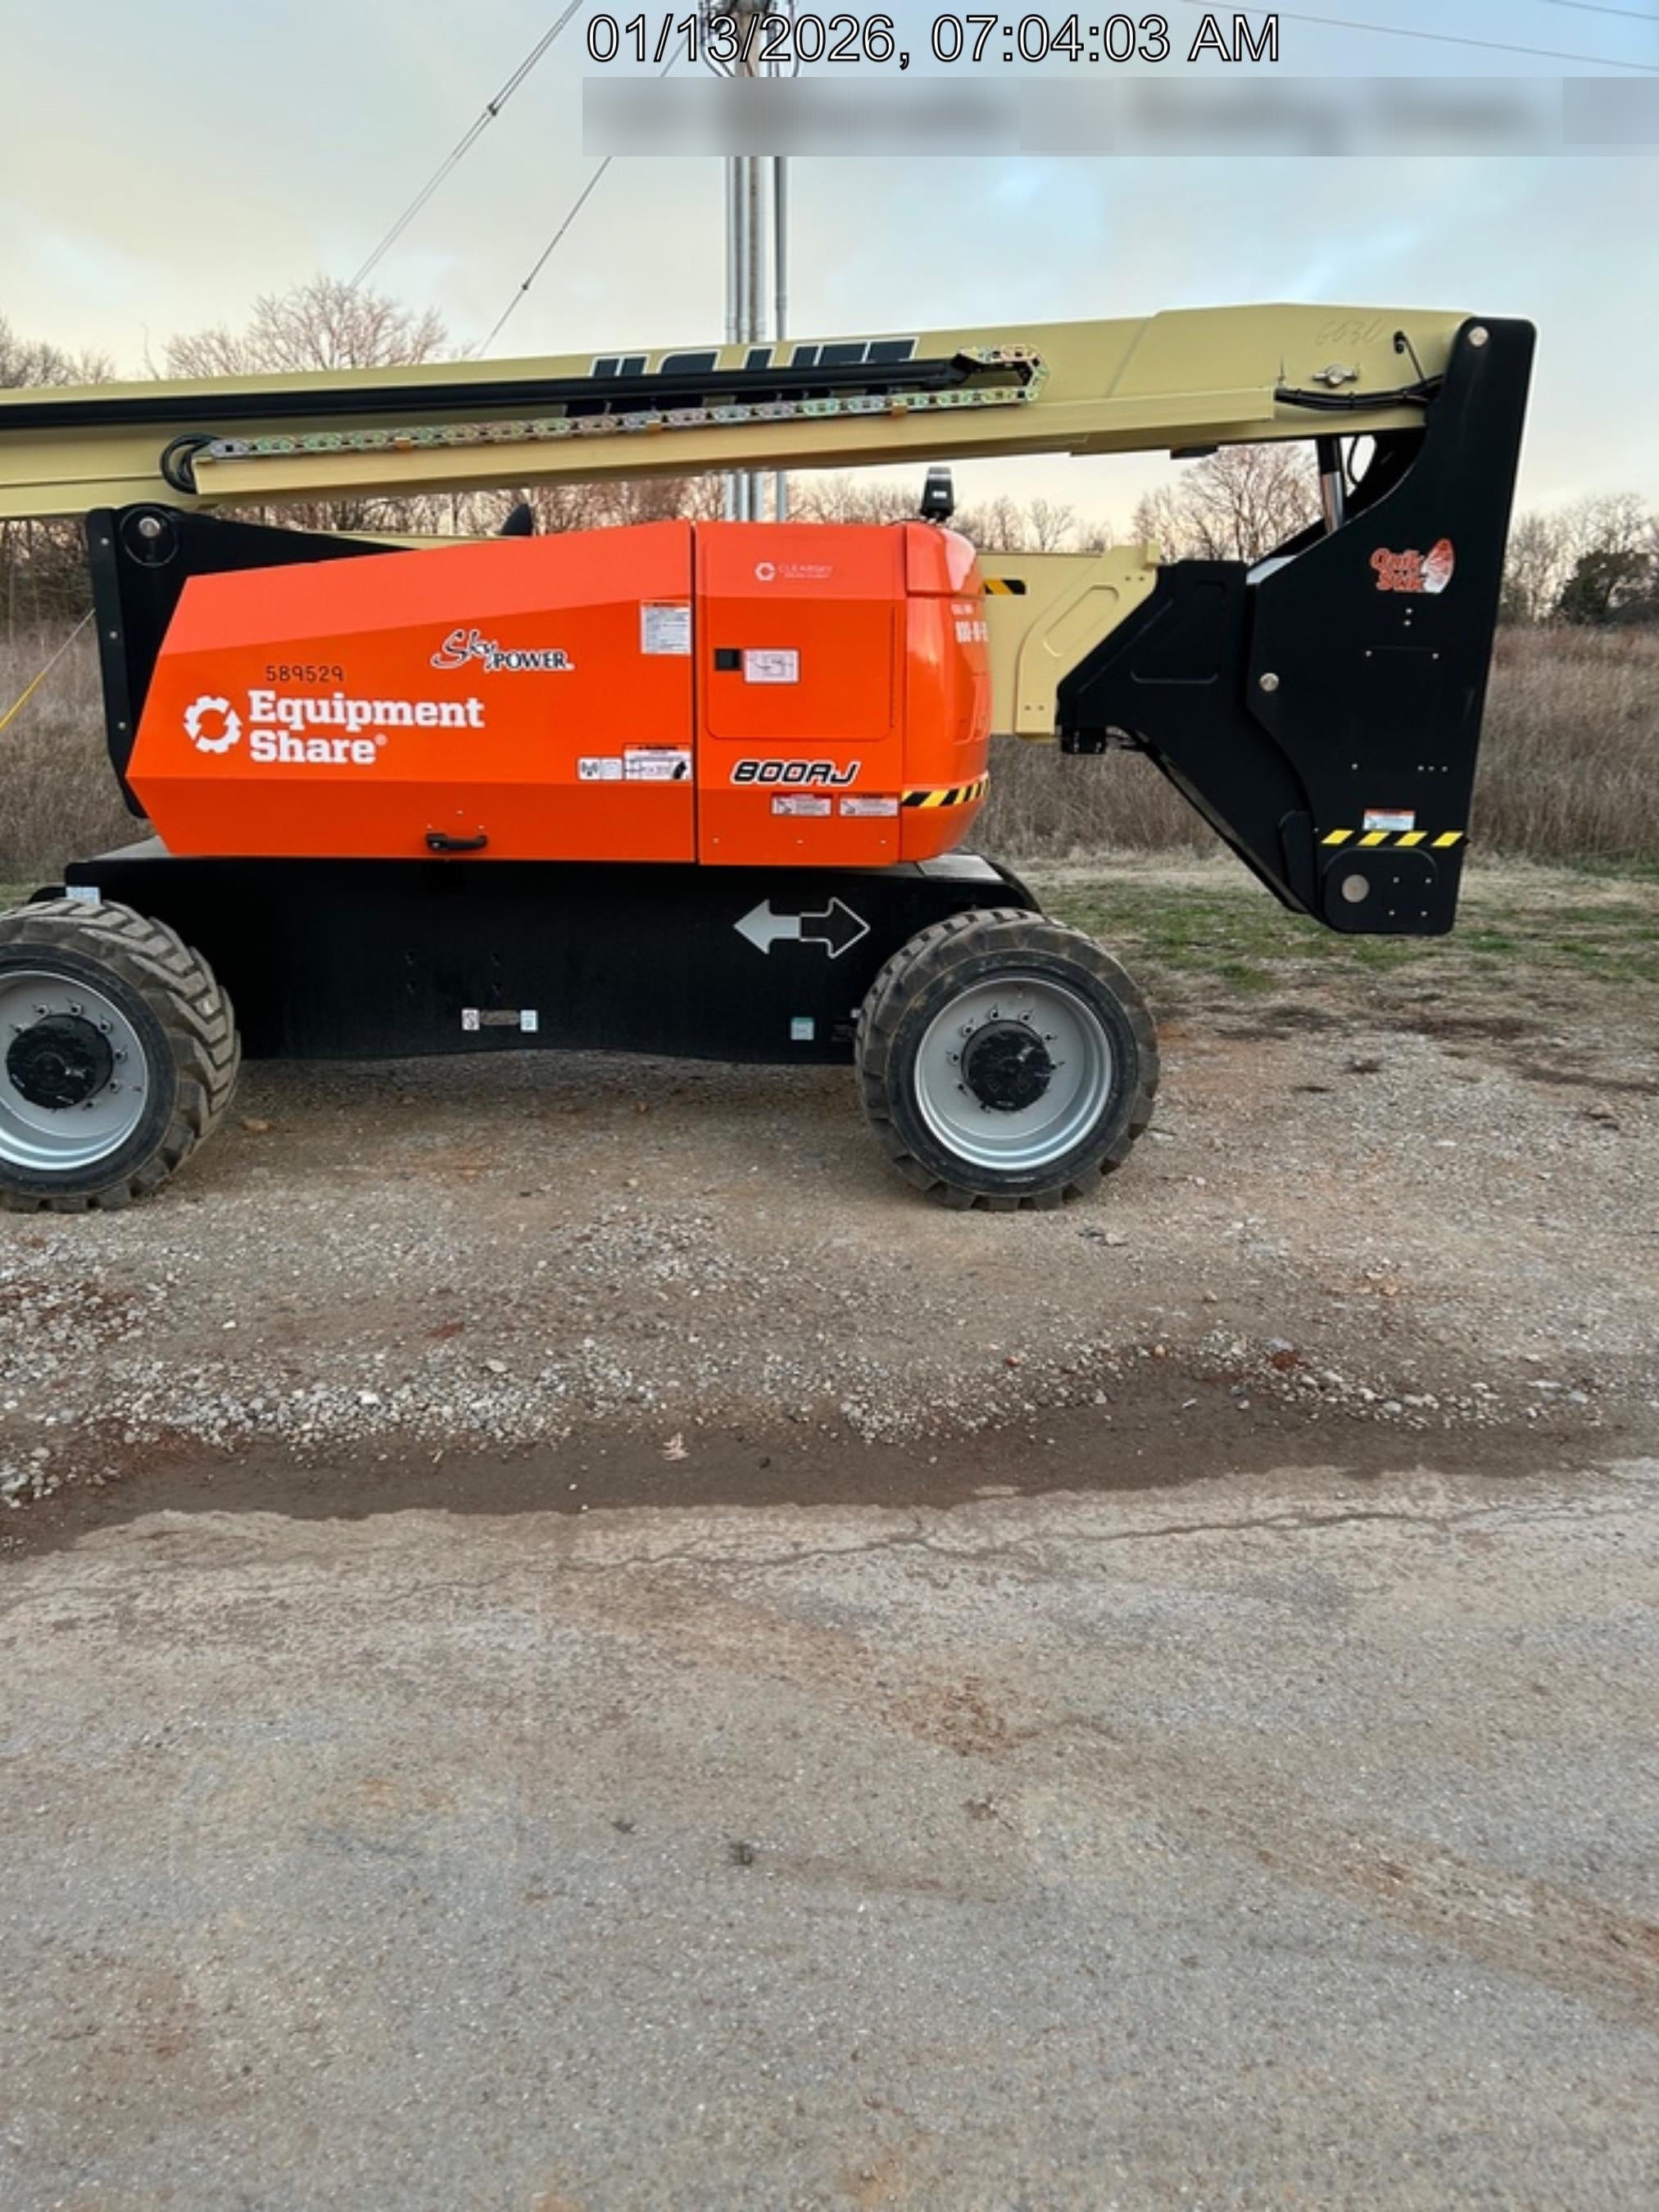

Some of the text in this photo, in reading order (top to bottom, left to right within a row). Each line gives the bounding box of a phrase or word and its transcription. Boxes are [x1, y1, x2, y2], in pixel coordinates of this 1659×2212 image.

[491, 649, 569, 672] POWER
[265, 665, 344, 682] 589529
[247, 689, 485, 732] Equipment
[730, 759, 861, 786] 800AJ
